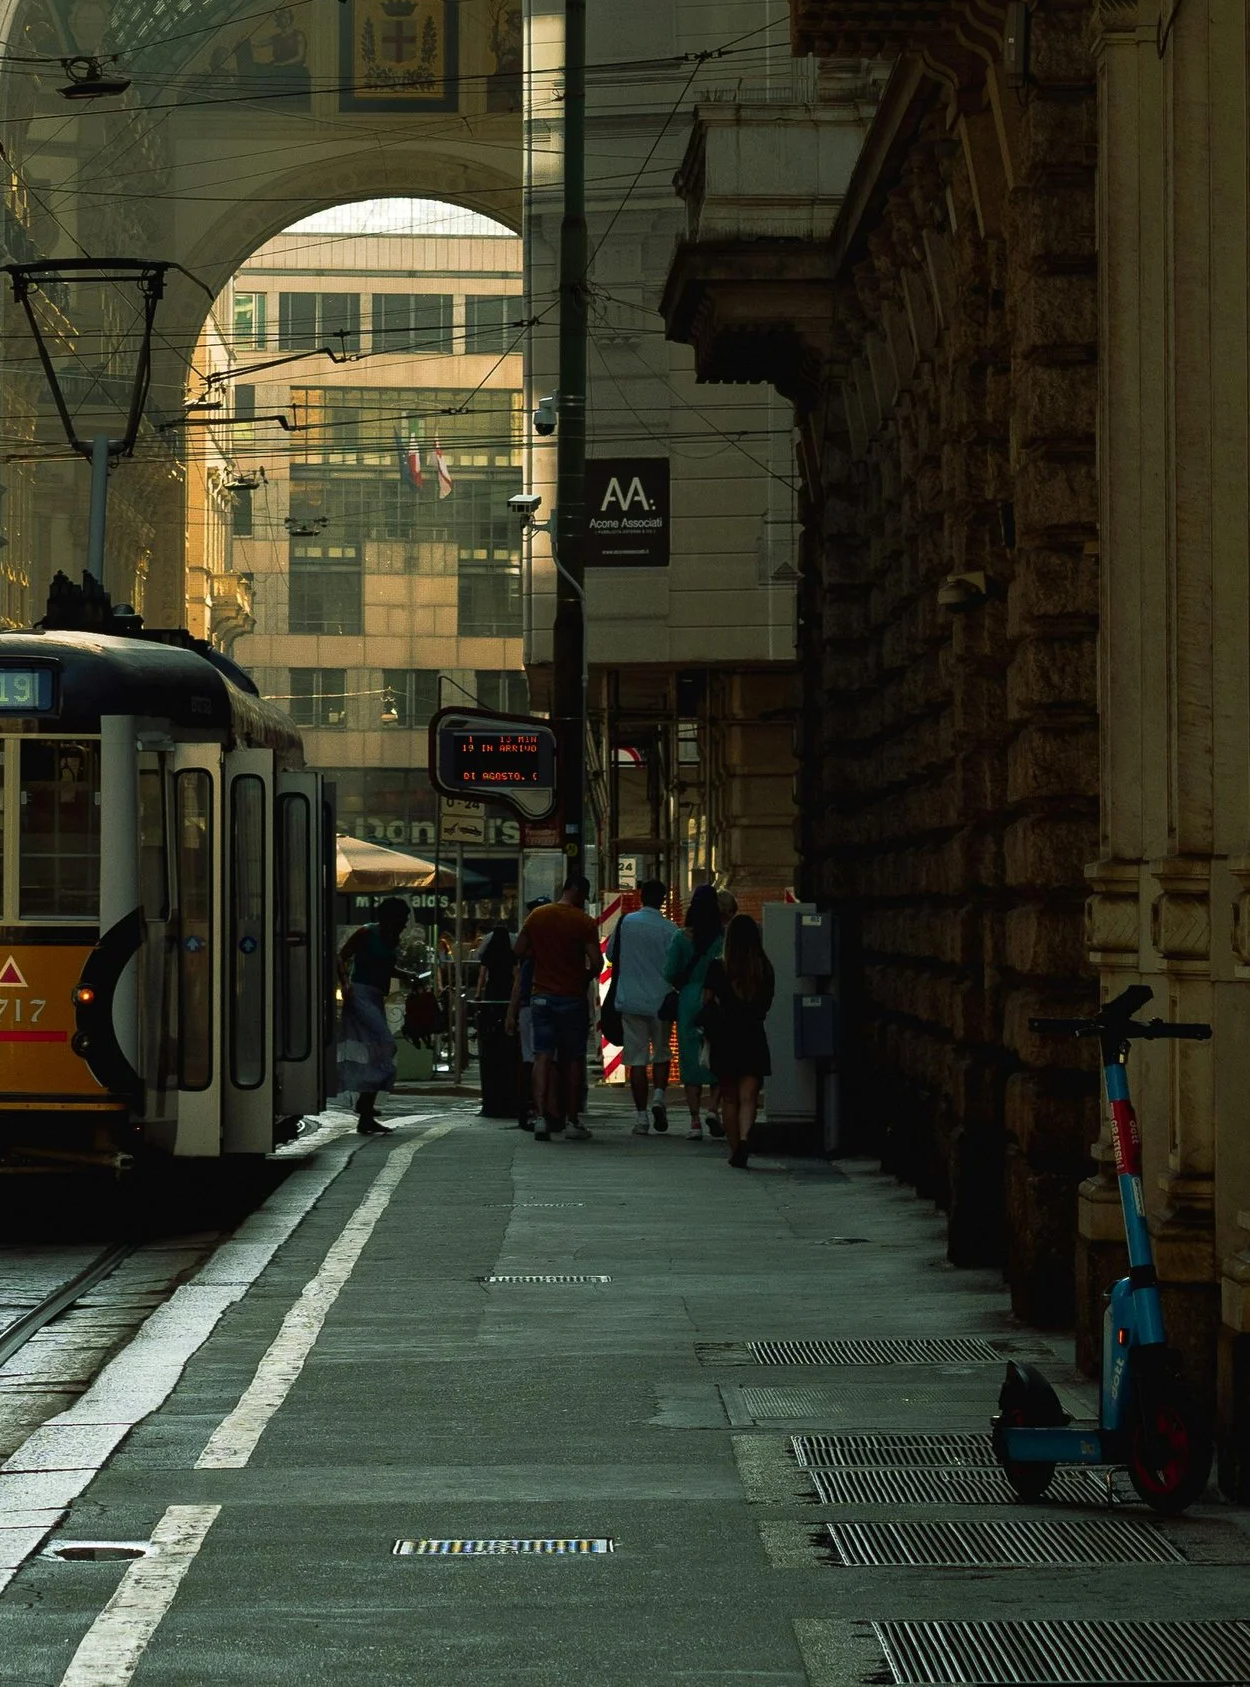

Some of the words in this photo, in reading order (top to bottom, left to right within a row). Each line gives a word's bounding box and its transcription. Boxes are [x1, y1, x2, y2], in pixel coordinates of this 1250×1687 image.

[589, 518, 618, 528] Acone
[621, 517, 662, 528] Associati
[462, 744, 474, 752] 19
[482, 744, 493, 752] IN
[499, 744, 537, 752] ARRIVO
[463, 772, 476, 780] DI
[1111, 1357, 1125, 1400] dott
